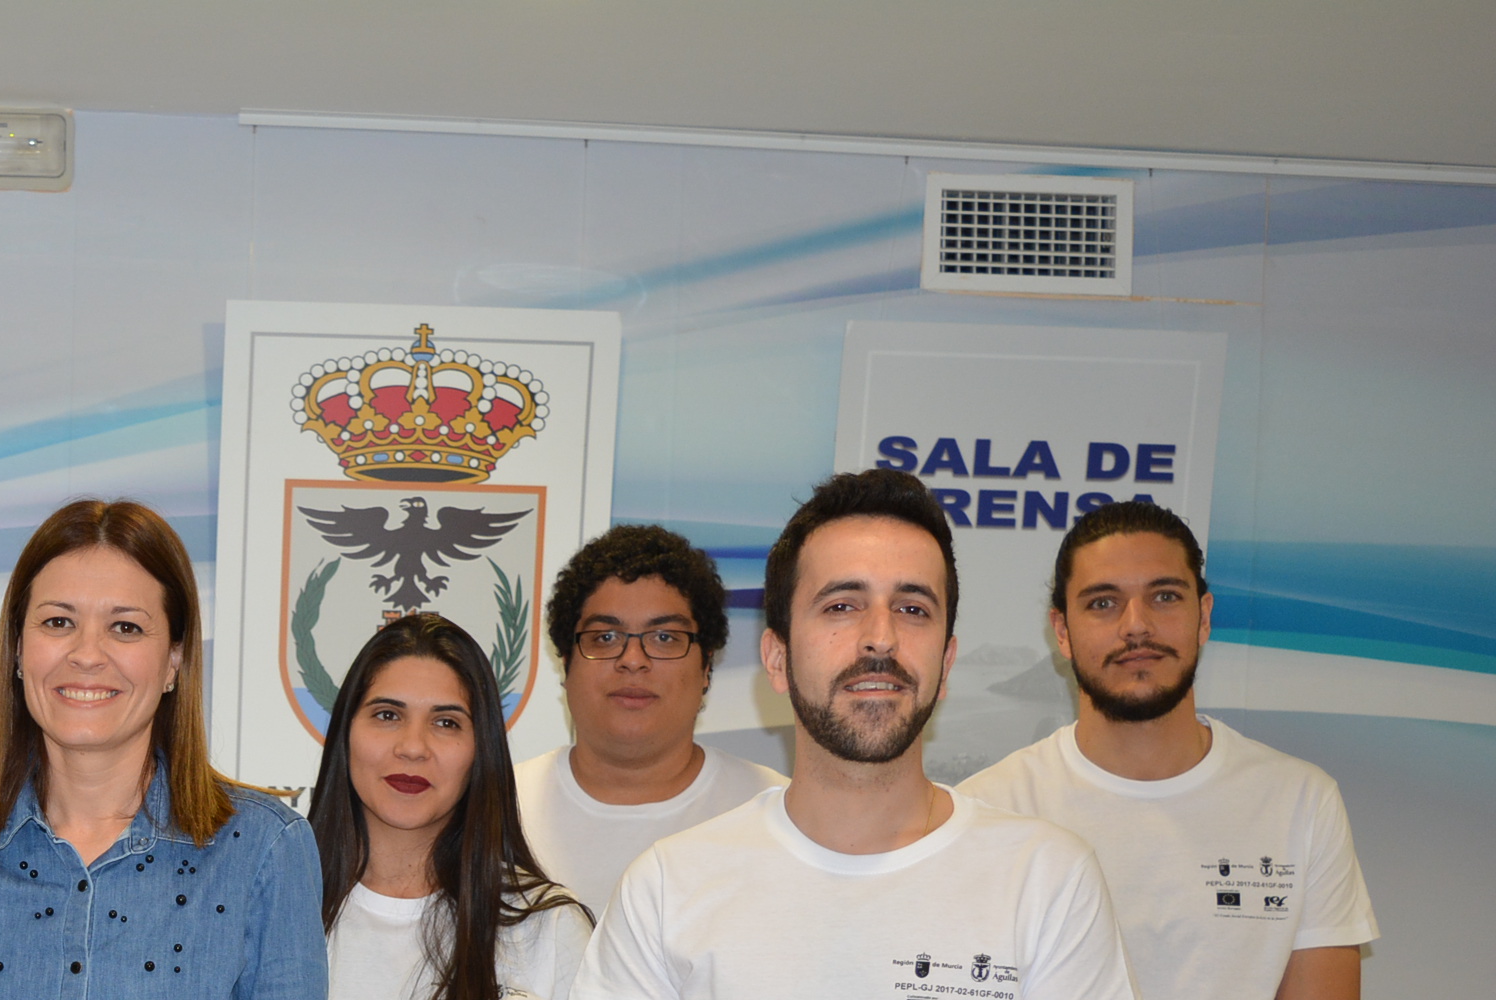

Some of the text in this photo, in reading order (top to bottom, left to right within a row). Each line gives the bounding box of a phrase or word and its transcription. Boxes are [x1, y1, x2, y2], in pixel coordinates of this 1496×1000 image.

[876, 435, 1176, 483] SALA DE
[930, 488, 1156, 529] RENS
[895, 983, 933, 991] PEPL-GJ
[936, 985, 1014, 1000] 2017-02-61GF-0010
